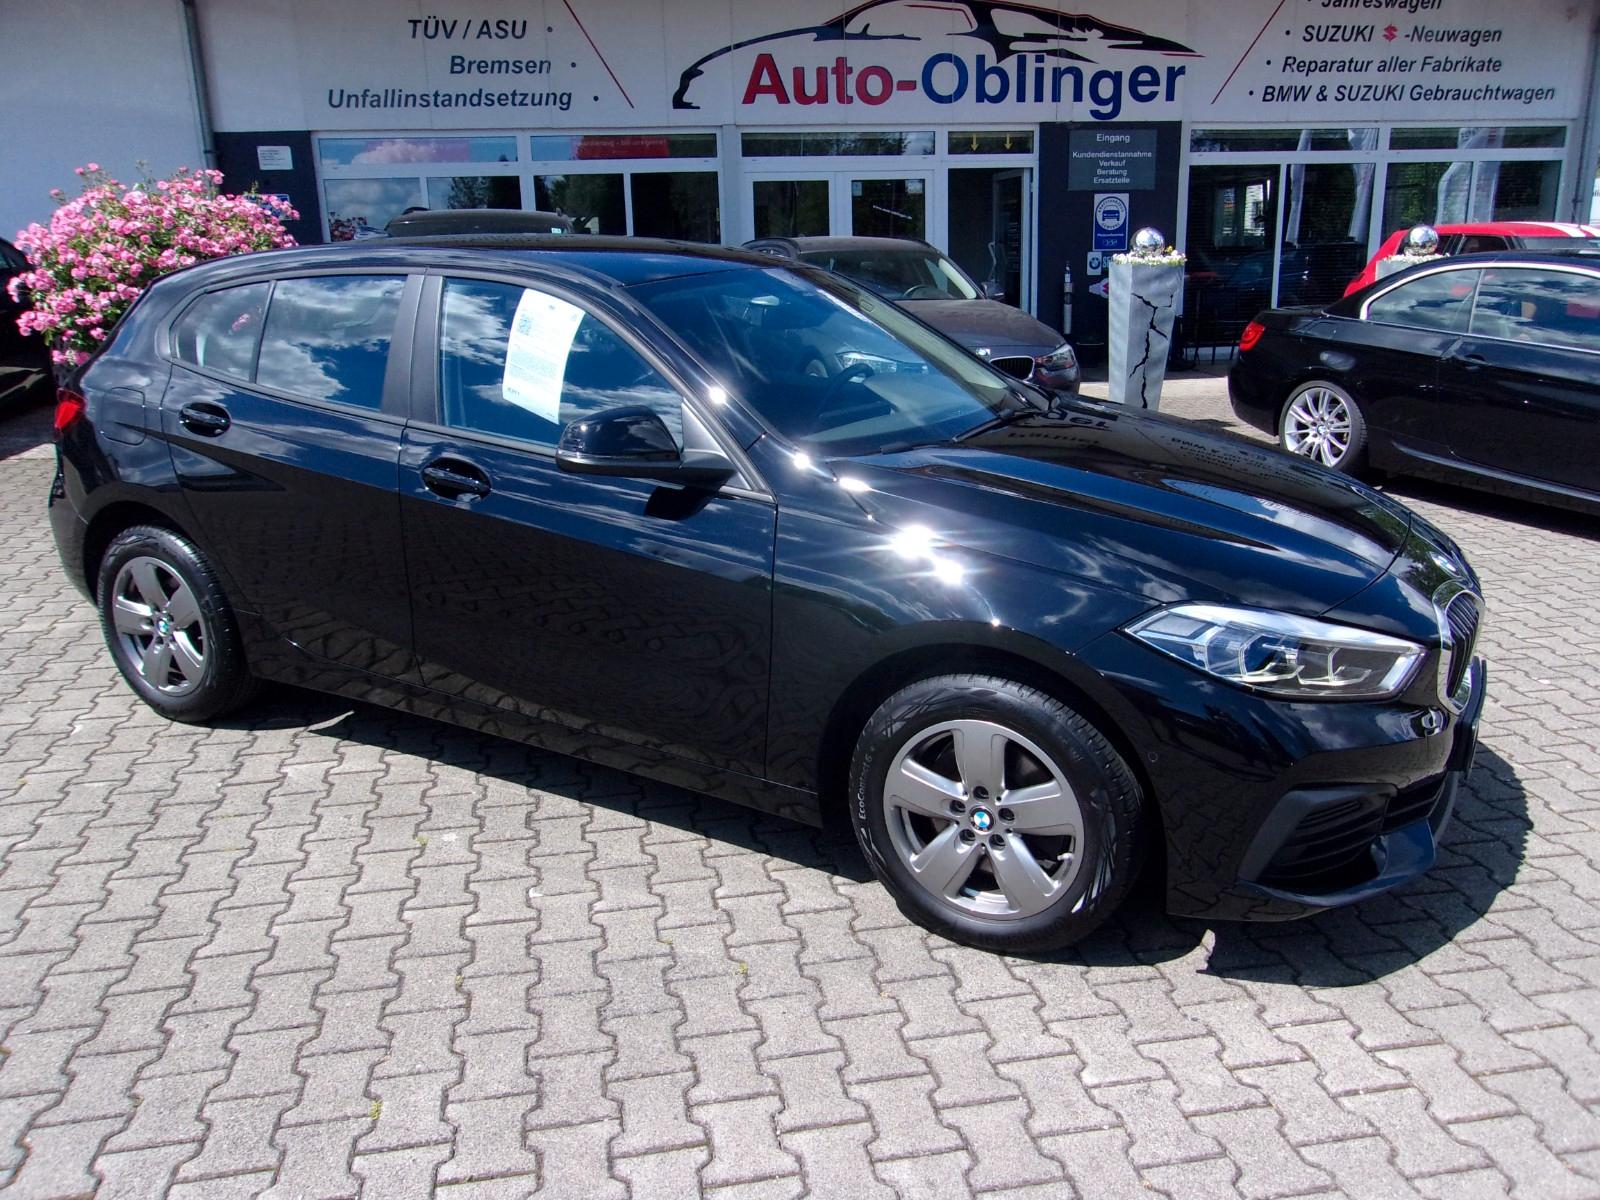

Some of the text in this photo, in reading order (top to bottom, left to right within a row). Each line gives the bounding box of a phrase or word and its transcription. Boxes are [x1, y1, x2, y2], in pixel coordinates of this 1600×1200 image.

[408, 15, 456, 39] TÜV
[476, 19, 527, 39] ASU
[1302, 25, 1374, 42] SUZUKI
[1404, 26, 1502, 47] -Neuwagen
[450, 55, 551, 74] Bremsen
[1282, 55, 1502, 76] Reparatur aller Fabrikate
[741, 51, 1186, 121] Auto-Oblinger
[1262, 85, 1555, 104] BMW & SUZUKI Gebrauchtwagen
[328, 88, 572, 111] Unfallinstandsetzung
[1096, 133, 1131, 143] Eingang
[1097, 168, 1128, 176] Beratung
[1099, 159, 1126, 167] Verkauf
[1093, 176, 1130, 184] Ersatzteile
